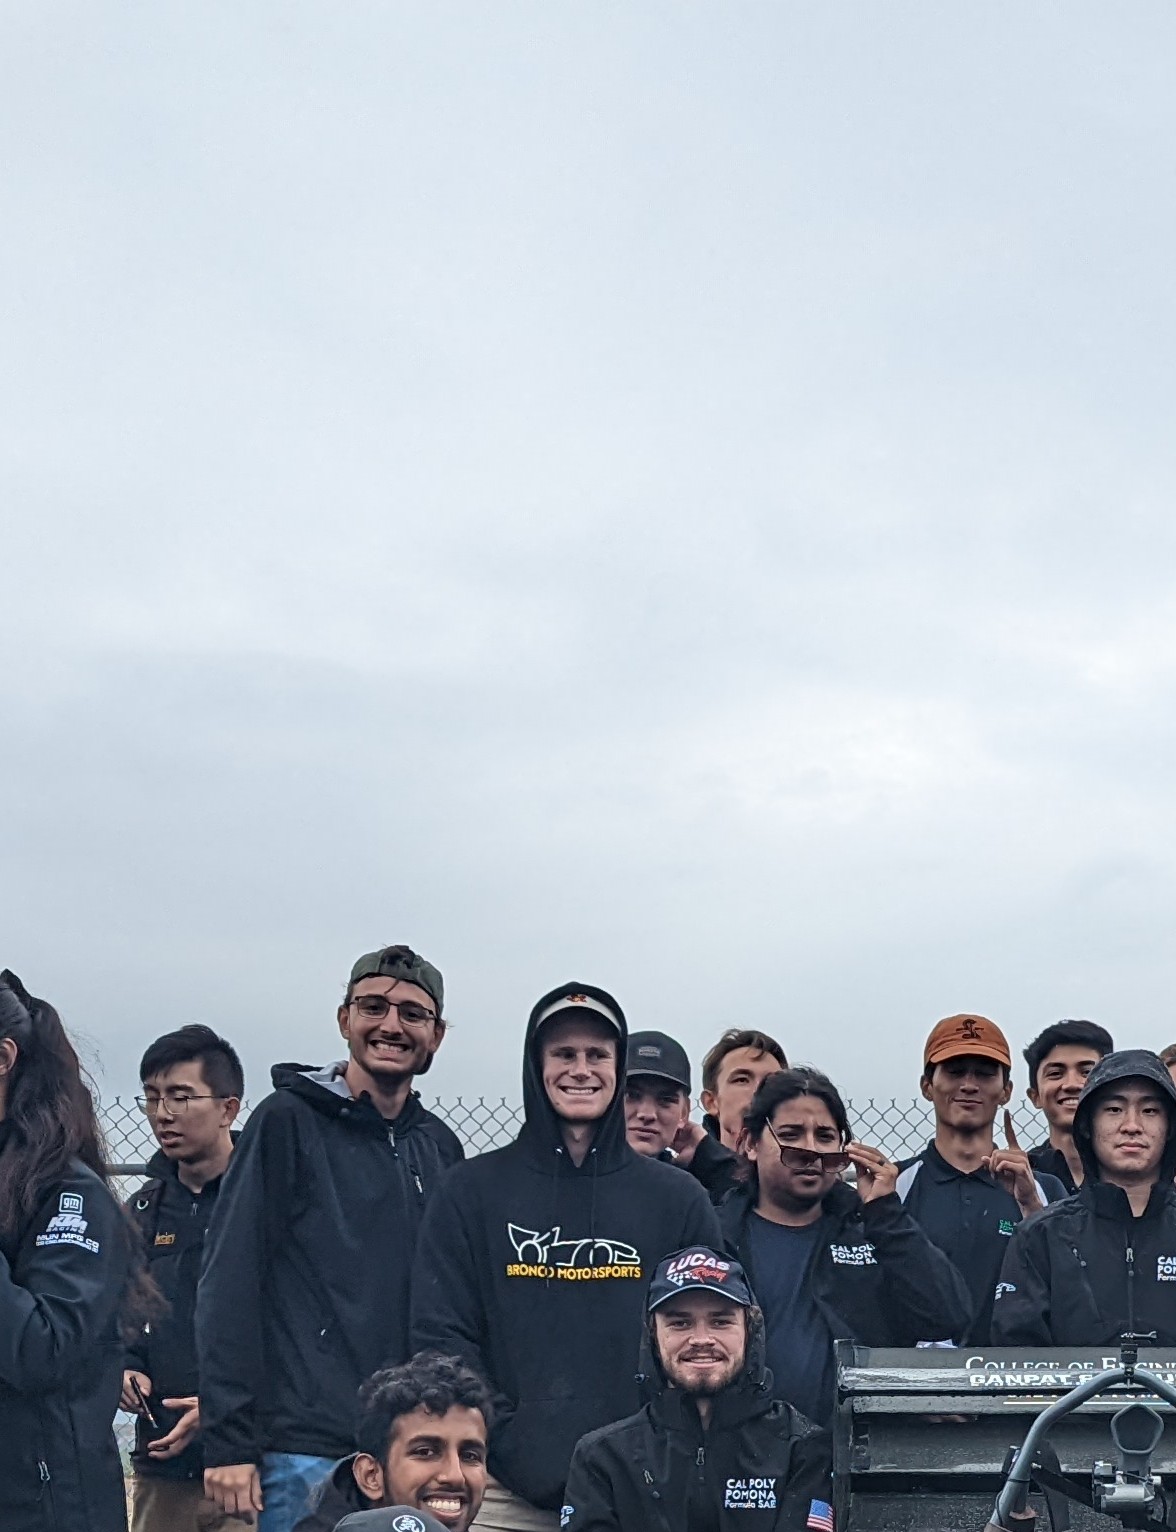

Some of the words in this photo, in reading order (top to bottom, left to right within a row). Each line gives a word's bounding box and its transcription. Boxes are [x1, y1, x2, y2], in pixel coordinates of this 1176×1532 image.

[63, 1197, 80, 1209] gm
[830, 1244, 850, 1253] CAL
[666, 1253, 731, 1276] LUCAS
[506, 1264, 554, 1278] BRONCO
[557, 1266, 641, 1280] MOTORSPORTS
[726, 1478, 747, 1489] CAL
[749, 1478, 777, 1489] POLY
[725, 1489, 777, 1500] POMONA
[724, 1499, 756, 1509] Formula
[757, 1499, 777, 1509] SAE
